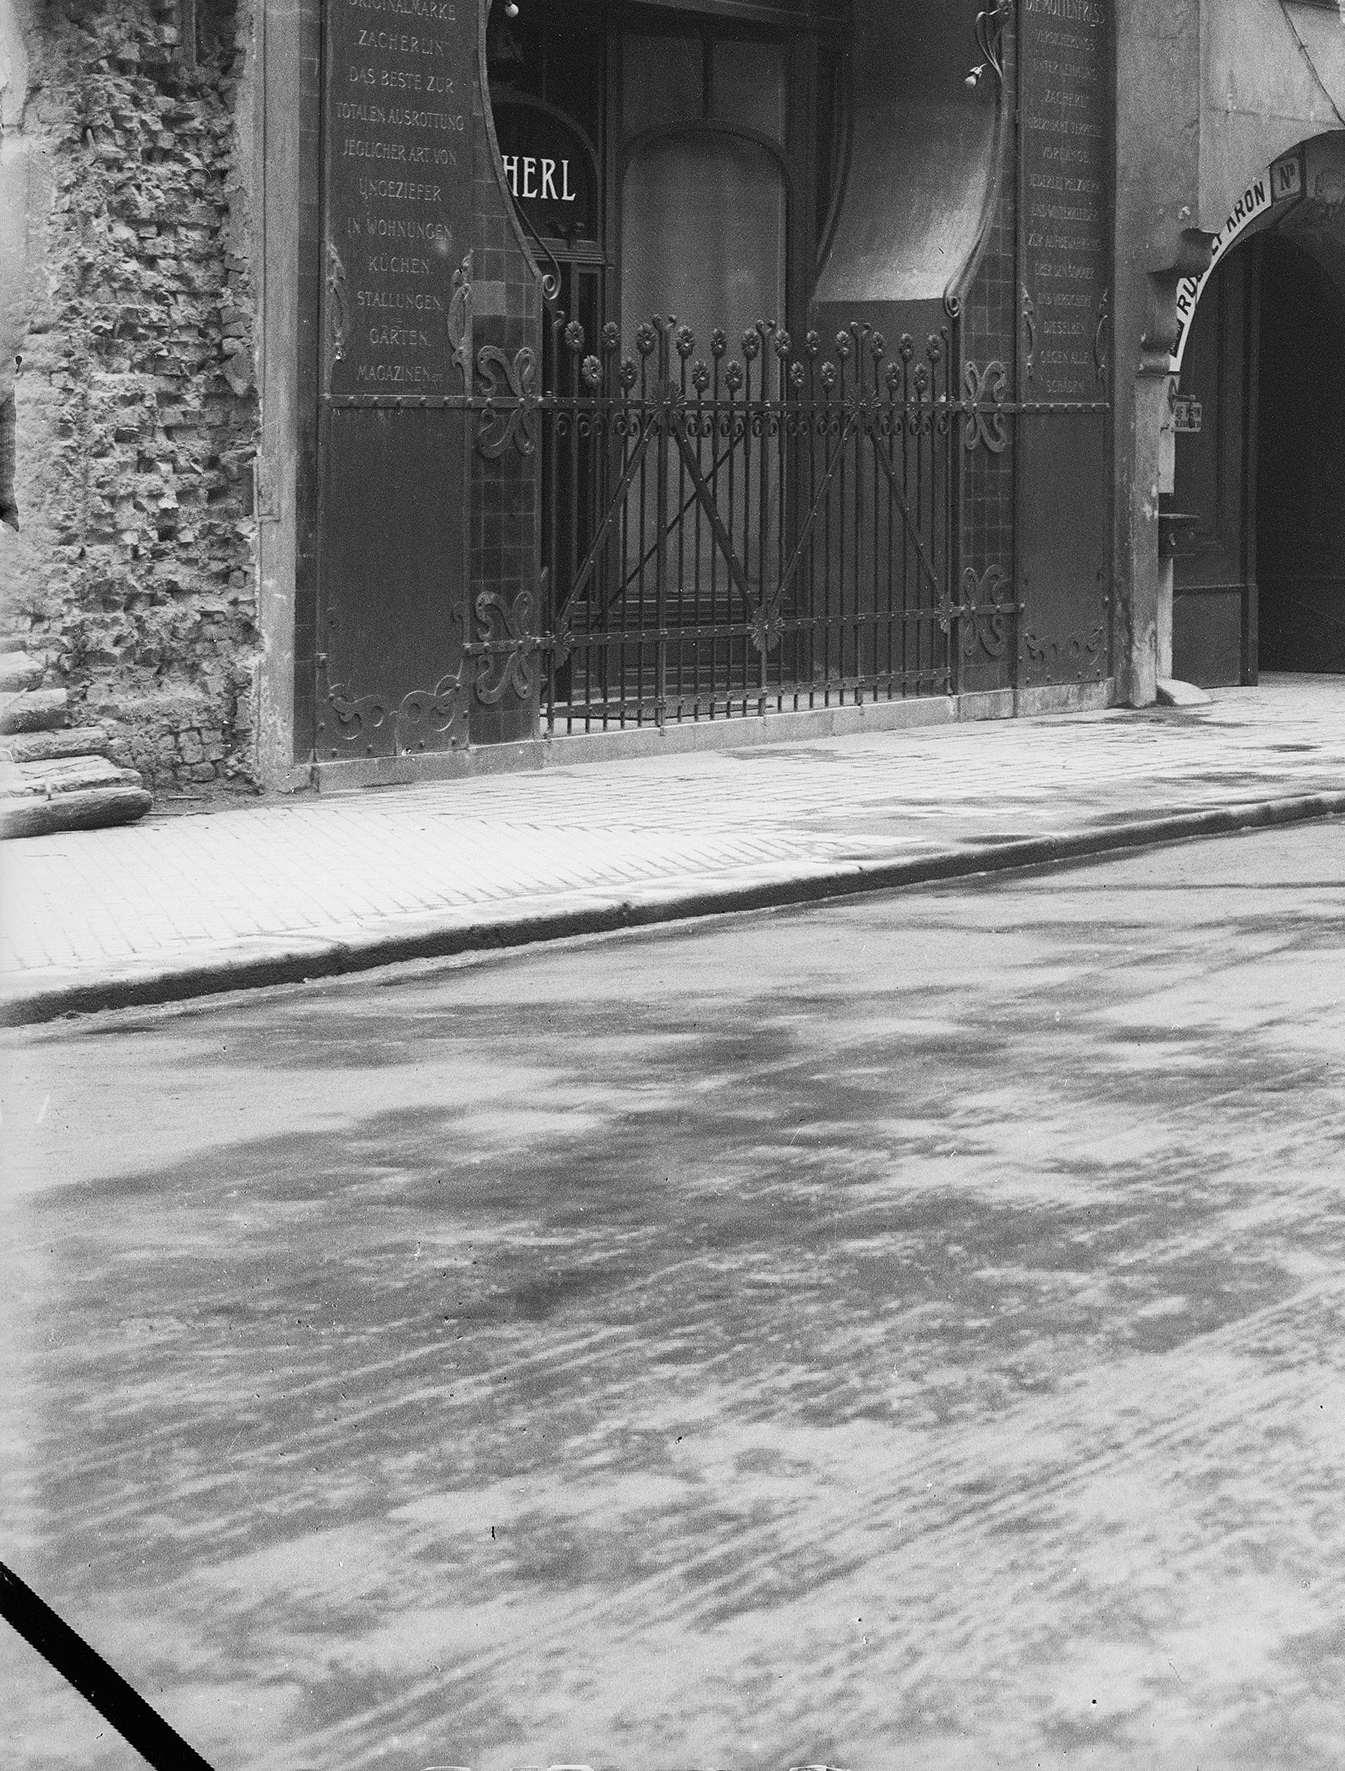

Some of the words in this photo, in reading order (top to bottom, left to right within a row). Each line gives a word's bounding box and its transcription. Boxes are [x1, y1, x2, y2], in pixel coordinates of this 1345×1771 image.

[349, 66, 376, 85] DAS
[381, 70, 422, 91] BESTE
[426, 75, 455, 95] ZUR
[336, 102, 386, 123] TOTALEN
[388, 108, 465, 132] AUSROTTUNG
[342, 138, 407, 162] JEGLICHER
[409, 146, 430, 163] ART
[434, 148, 457, 166] VON
[359, 178, 442, 202] UNGEZIEFER
[502, 155, 576, 201] HERL
[366, 217, 453, 240] WOHNUNGEN
